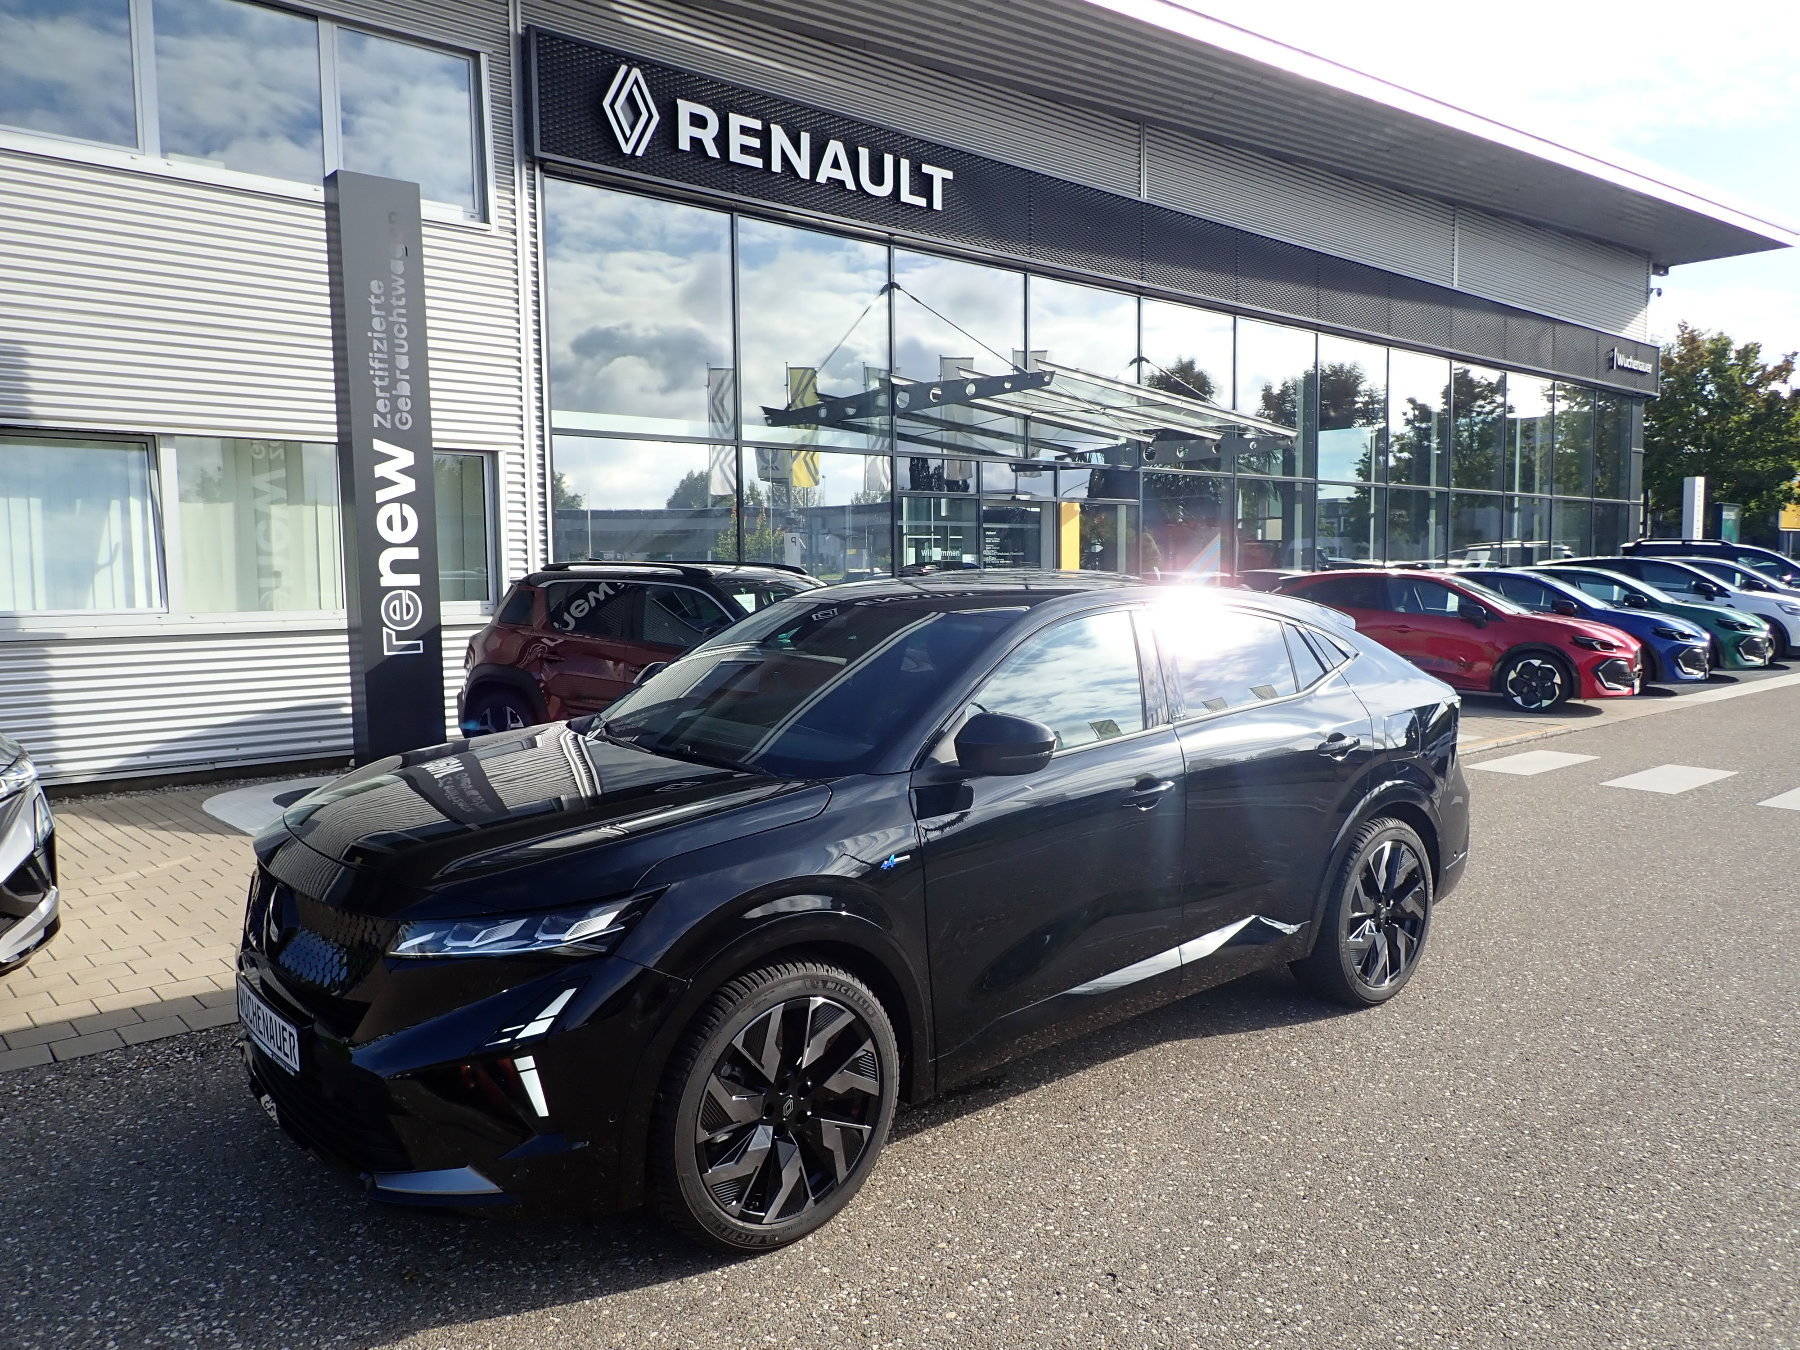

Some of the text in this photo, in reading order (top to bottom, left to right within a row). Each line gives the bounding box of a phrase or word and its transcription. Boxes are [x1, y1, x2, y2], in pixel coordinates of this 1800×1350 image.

[677, 98, 953, 211] RENAULT
[368, 279, 392, 429] Zertifizierte
[372, 438, 424, 656] renew
